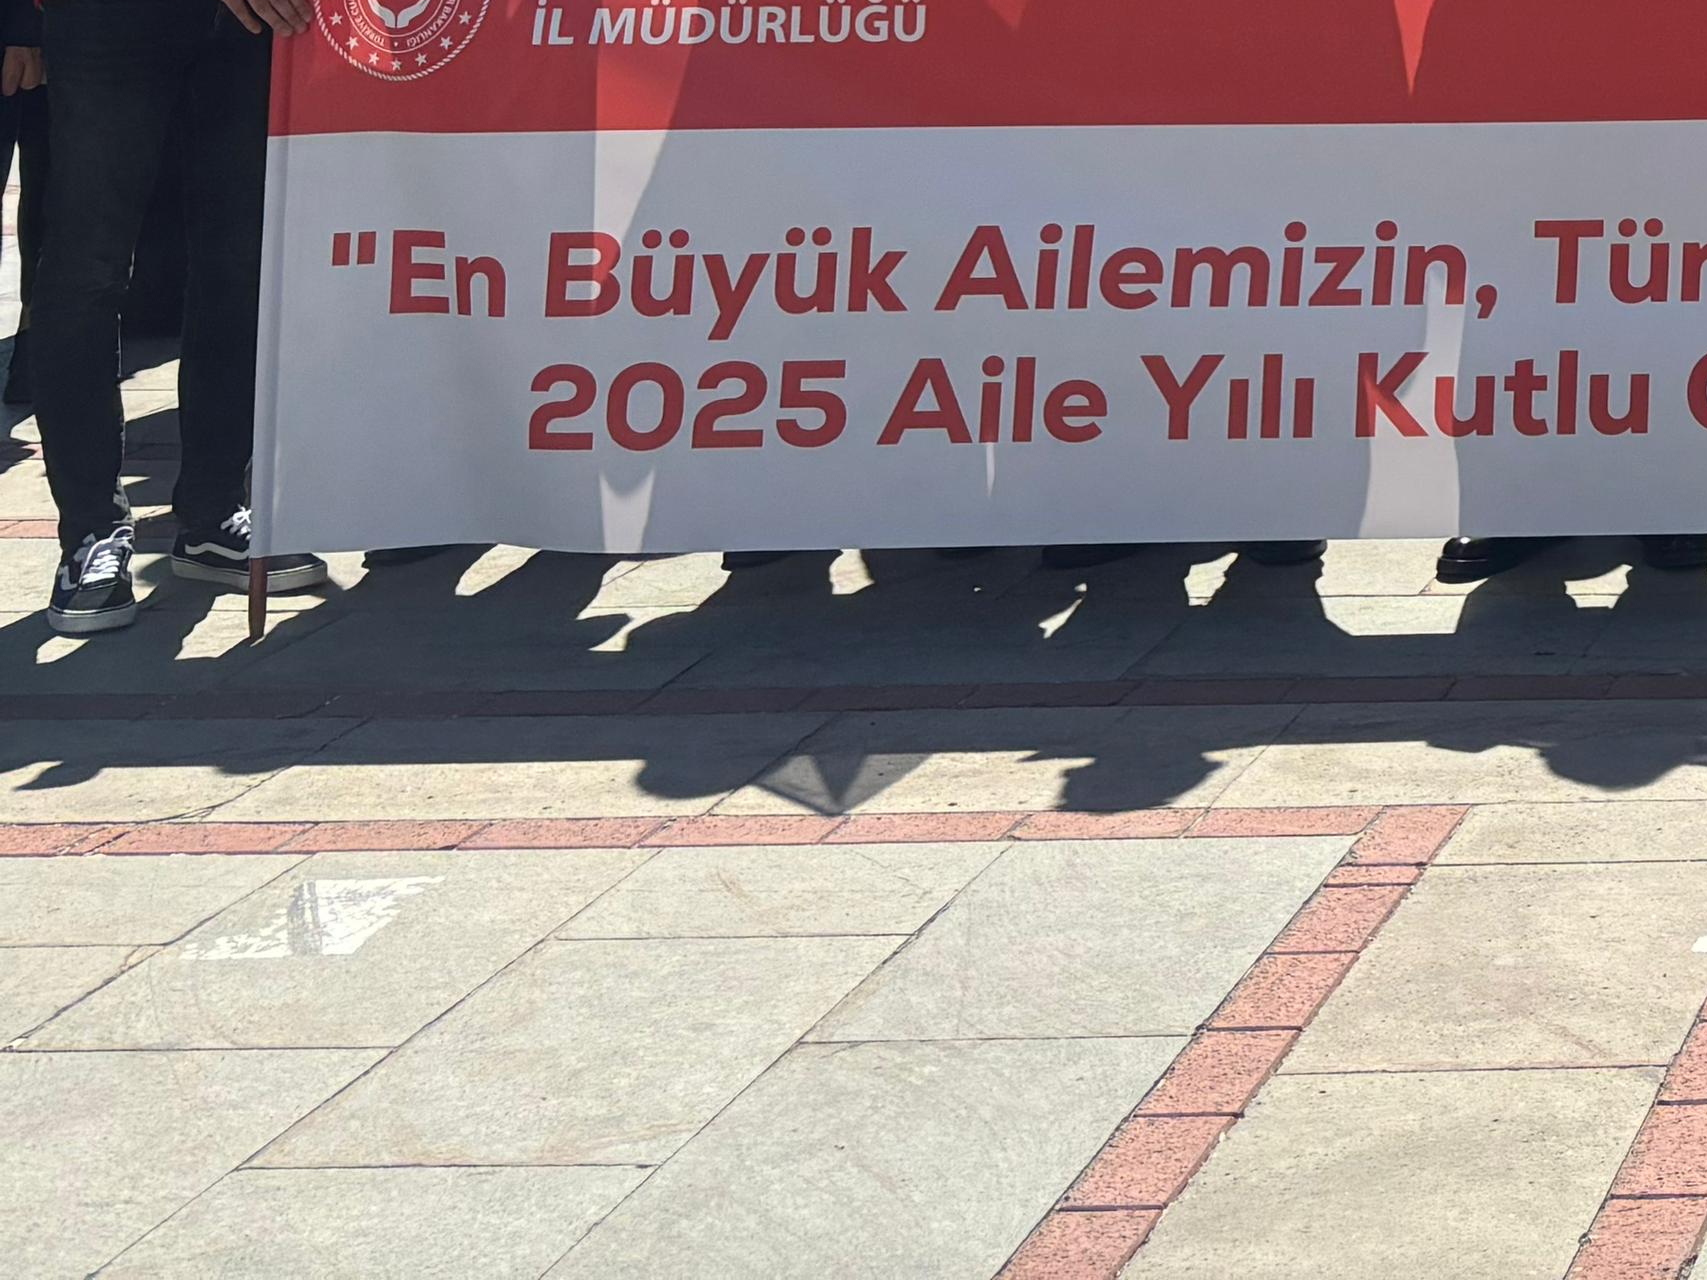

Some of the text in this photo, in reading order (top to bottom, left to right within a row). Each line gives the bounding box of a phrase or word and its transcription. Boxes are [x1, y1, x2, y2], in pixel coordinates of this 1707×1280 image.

[331, 229, 508, 318] "En
[544, 225, 908, 341] Büyük
[934, 219, 1499, 320] Ailemizin,
[527, 358, 849, 452] 2025
[875, 355, 1109, 446] Aile
[1140, 351, 1315, 441] Yılı
[1353, 350, 1649, 439] Kutlu
